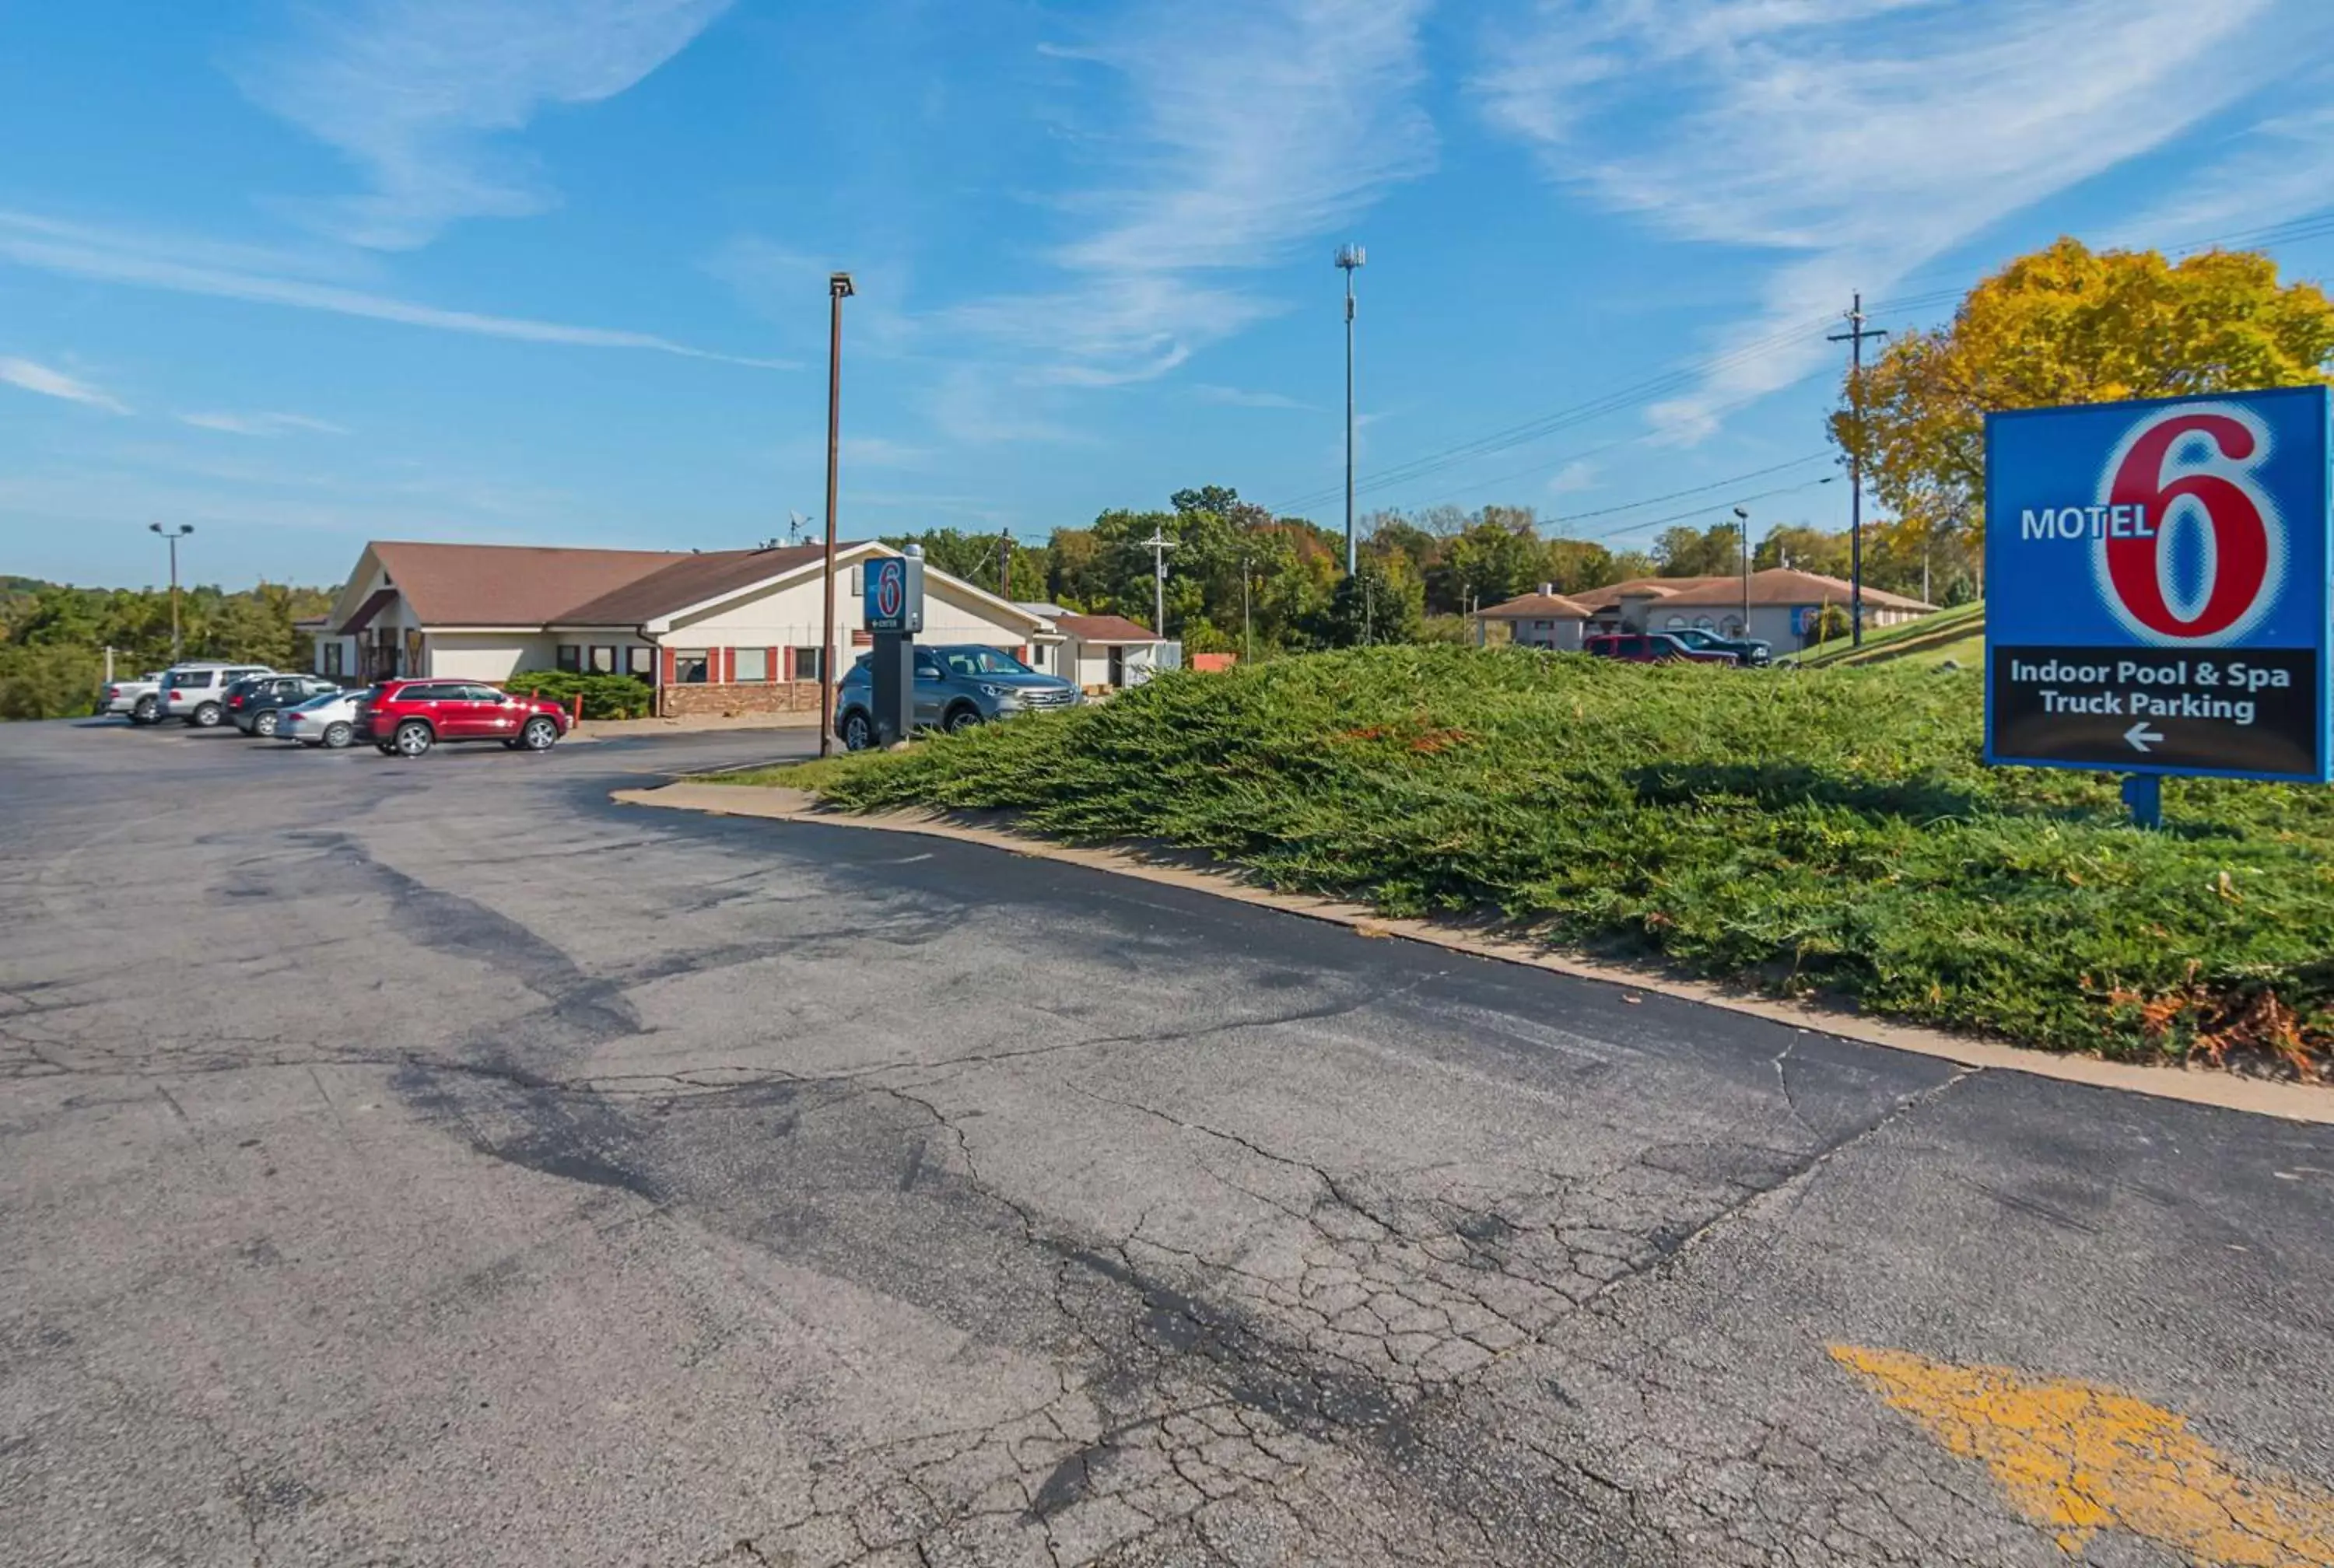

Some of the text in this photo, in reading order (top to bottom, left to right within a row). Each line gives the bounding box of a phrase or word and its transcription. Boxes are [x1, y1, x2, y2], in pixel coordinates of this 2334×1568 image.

[2022, 413, 2269, 638] MOTEL 6
[879, 562, 902, 615] 6
[2011, 660, 2290, 692] Indoor Pool & Spa
[2039, 690, 2254, 725] Truck Parking
